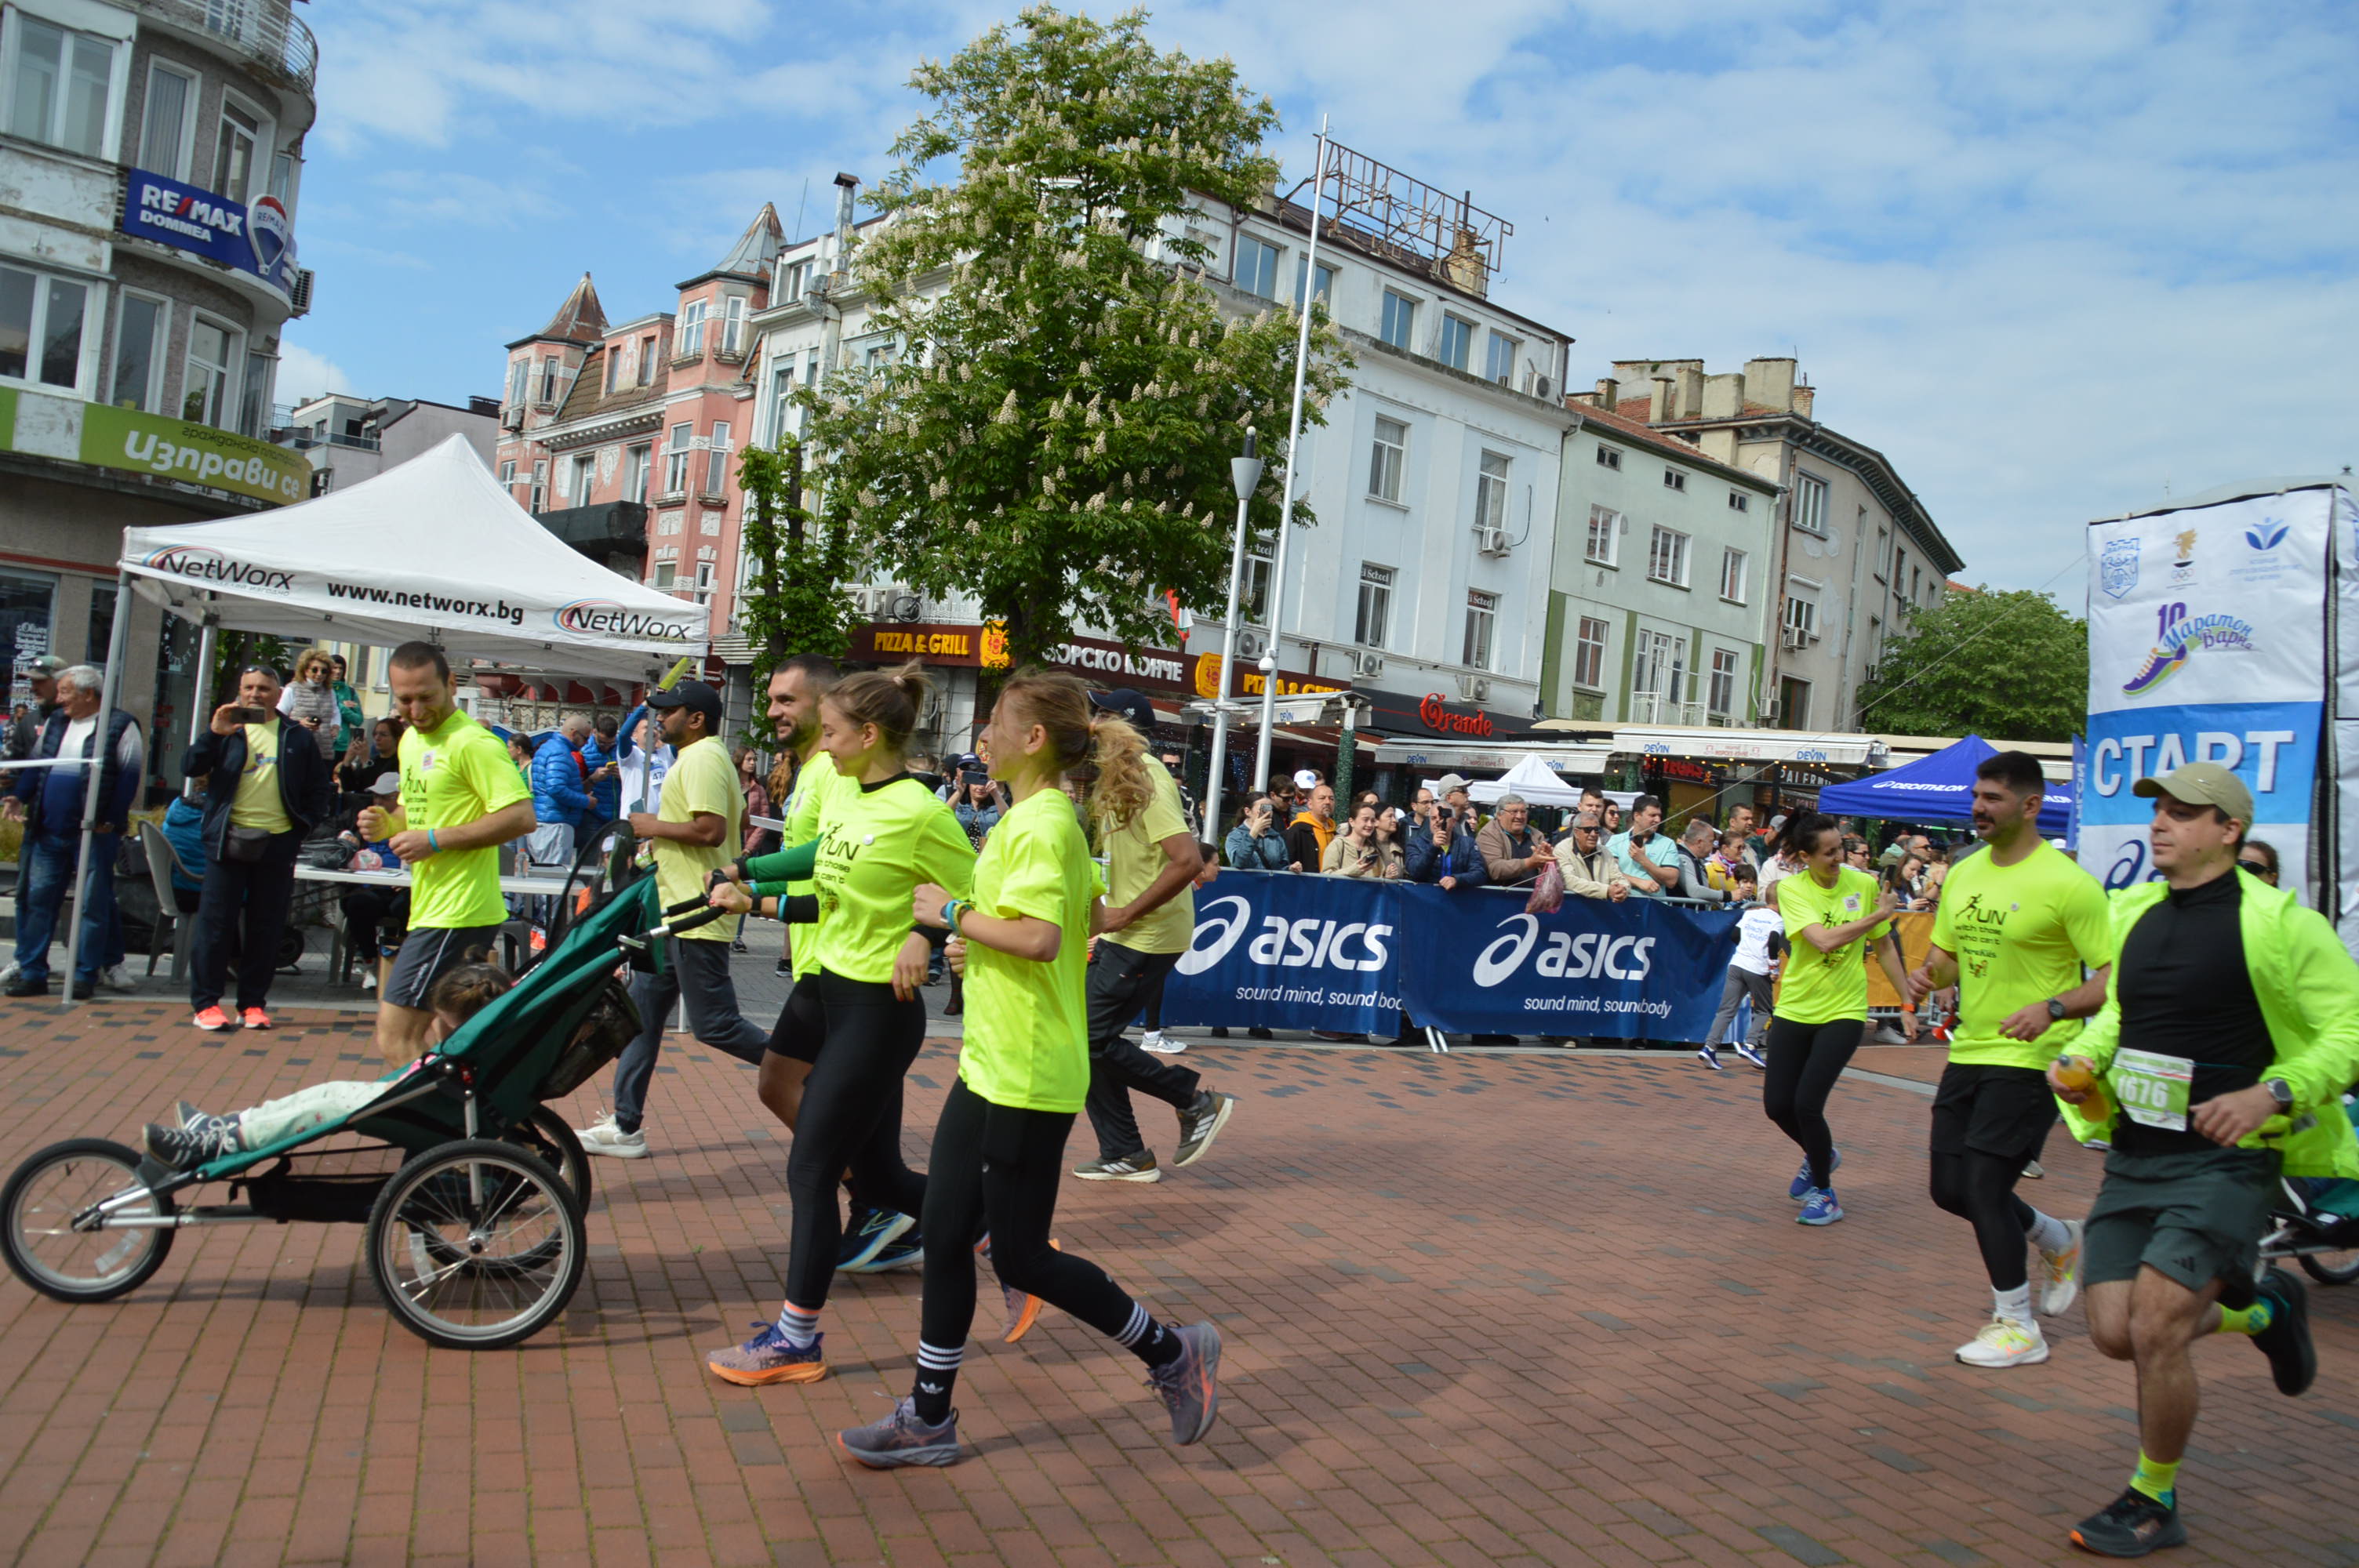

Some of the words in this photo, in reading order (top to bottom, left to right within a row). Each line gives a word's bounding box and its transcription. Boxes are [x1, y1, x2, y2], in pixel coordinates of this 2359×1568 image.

[140, 183, 243, 237] RE/MAX
[140, 209, 213, 242] DOMMEA
[257, 211, 284, 234] RE/MAX
[281, 474, 300, 499] се
[161, 554, 295, 590] NetWorx
[327, 582, 524, 626] www.networx.bg
[569, 607, 691, 640] NetWorx
[2157, 601, 2187, 644] 10
[2164, 613, 2254, 653] Маратон
[874, 631, 914, 652] PIZZA
[914, 633, 928, 653] &
[929, 633, 971, 655] GRILL
[2201, 628, 2253, 651] Варна
[1242, 673, 1285, 695] PIZA
[1419, 692, 1493, 737] Grande
[1407, 753, 1427, 764] DEVIN
[1644, 742, 1670, 753] DEVIN
[1797, 748, 1827, 761] DEVIN
[1891, 782, 1968, 792] DECATHLON
[823, 859, 851, 873] those
[1954, 923, 1977, 931] with
[1235, 985, 1283, 1001] sound
[1284, 985, 1324, 1006] mind,
[1328, 989, 1376, 1007] sound
[1378, 990, 1405, 1011] bo
[1524, 996, 1566, 1011] sound
[1567, 996, 1601, 1013] mind,
[1641, 998, 1672, 1019] body
[2118, 1074, 2169, 1109] 1676
